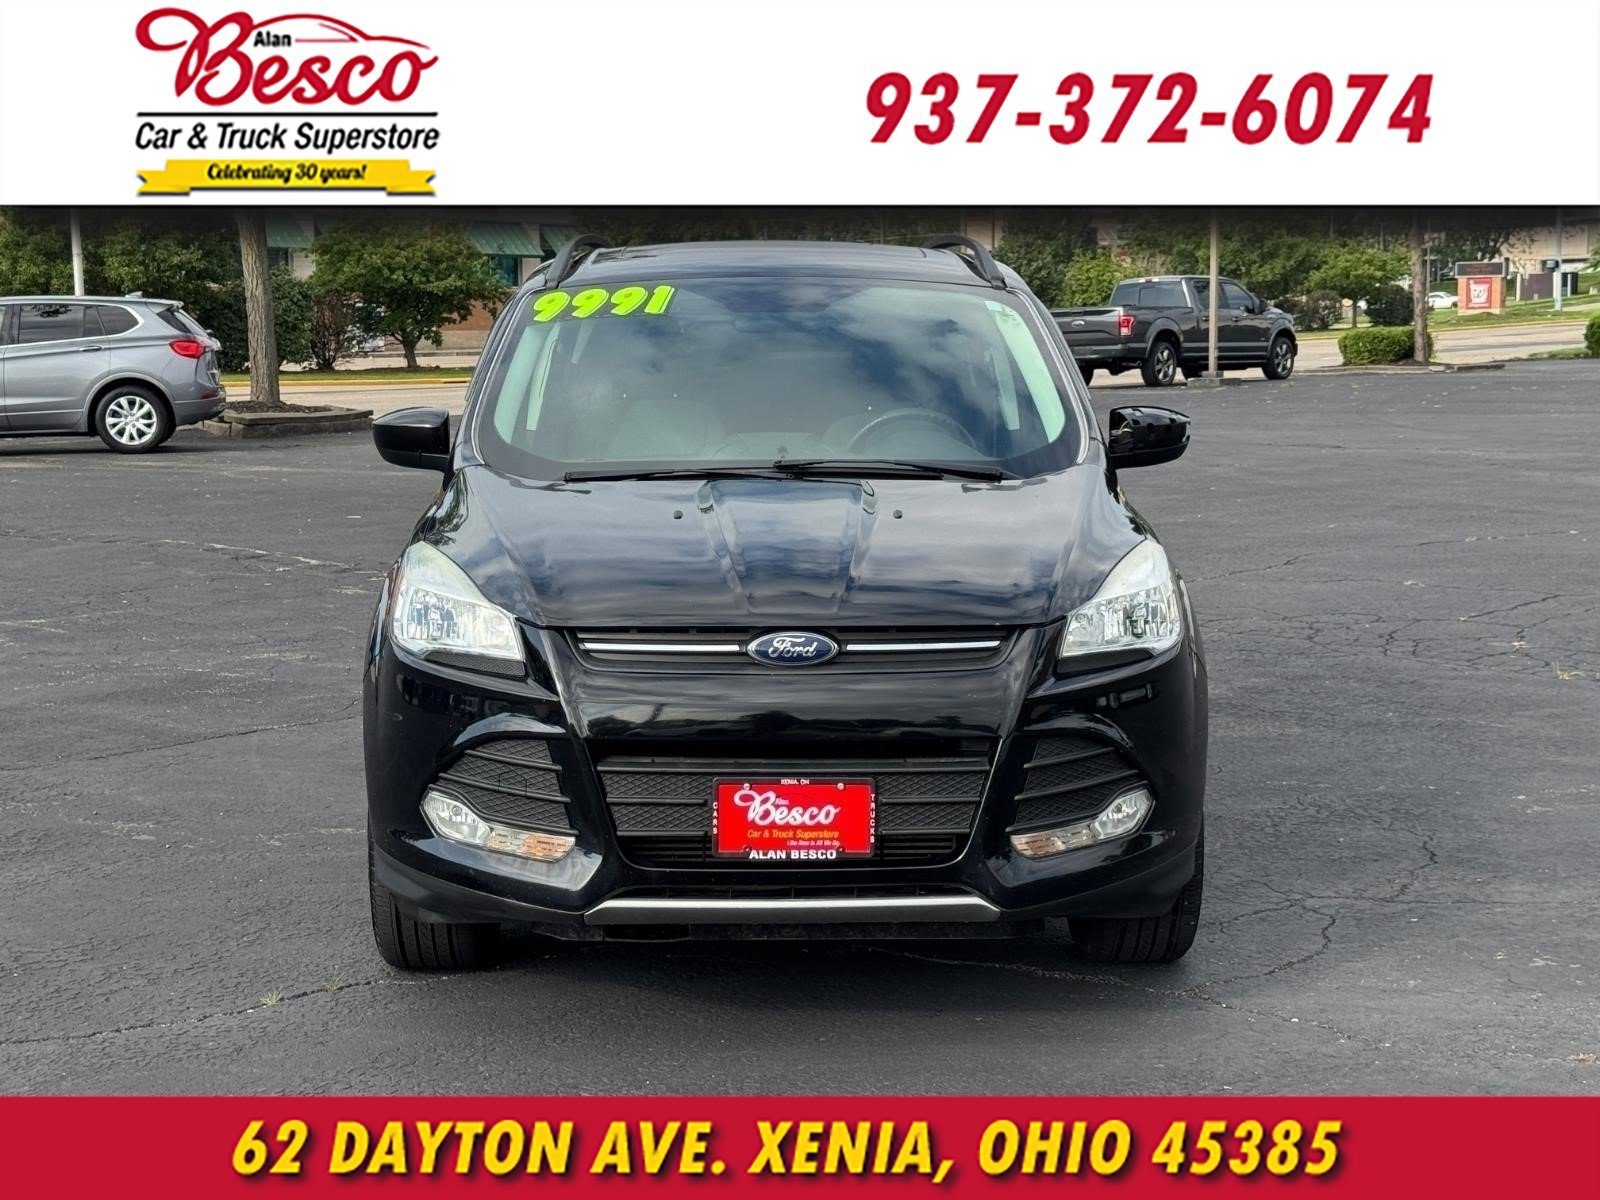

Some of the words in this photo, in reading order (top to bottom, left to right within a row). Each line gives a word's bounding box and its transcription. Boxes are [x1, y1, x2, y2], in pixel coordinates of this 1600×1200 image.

[533, 285, 675, 322] 9991
[768, 636, 818, 658] Ford
[733, 789, 841, 826] Besco
[747, 829, 762, 839] Car
[762, 829, 770, 839] &
[772, 829, 794, 839] Truck
[795, 829, 840, 840] Superstore
[748, 849, 786, 860] ALAN
[790, 849, 837, 860] BESCO
